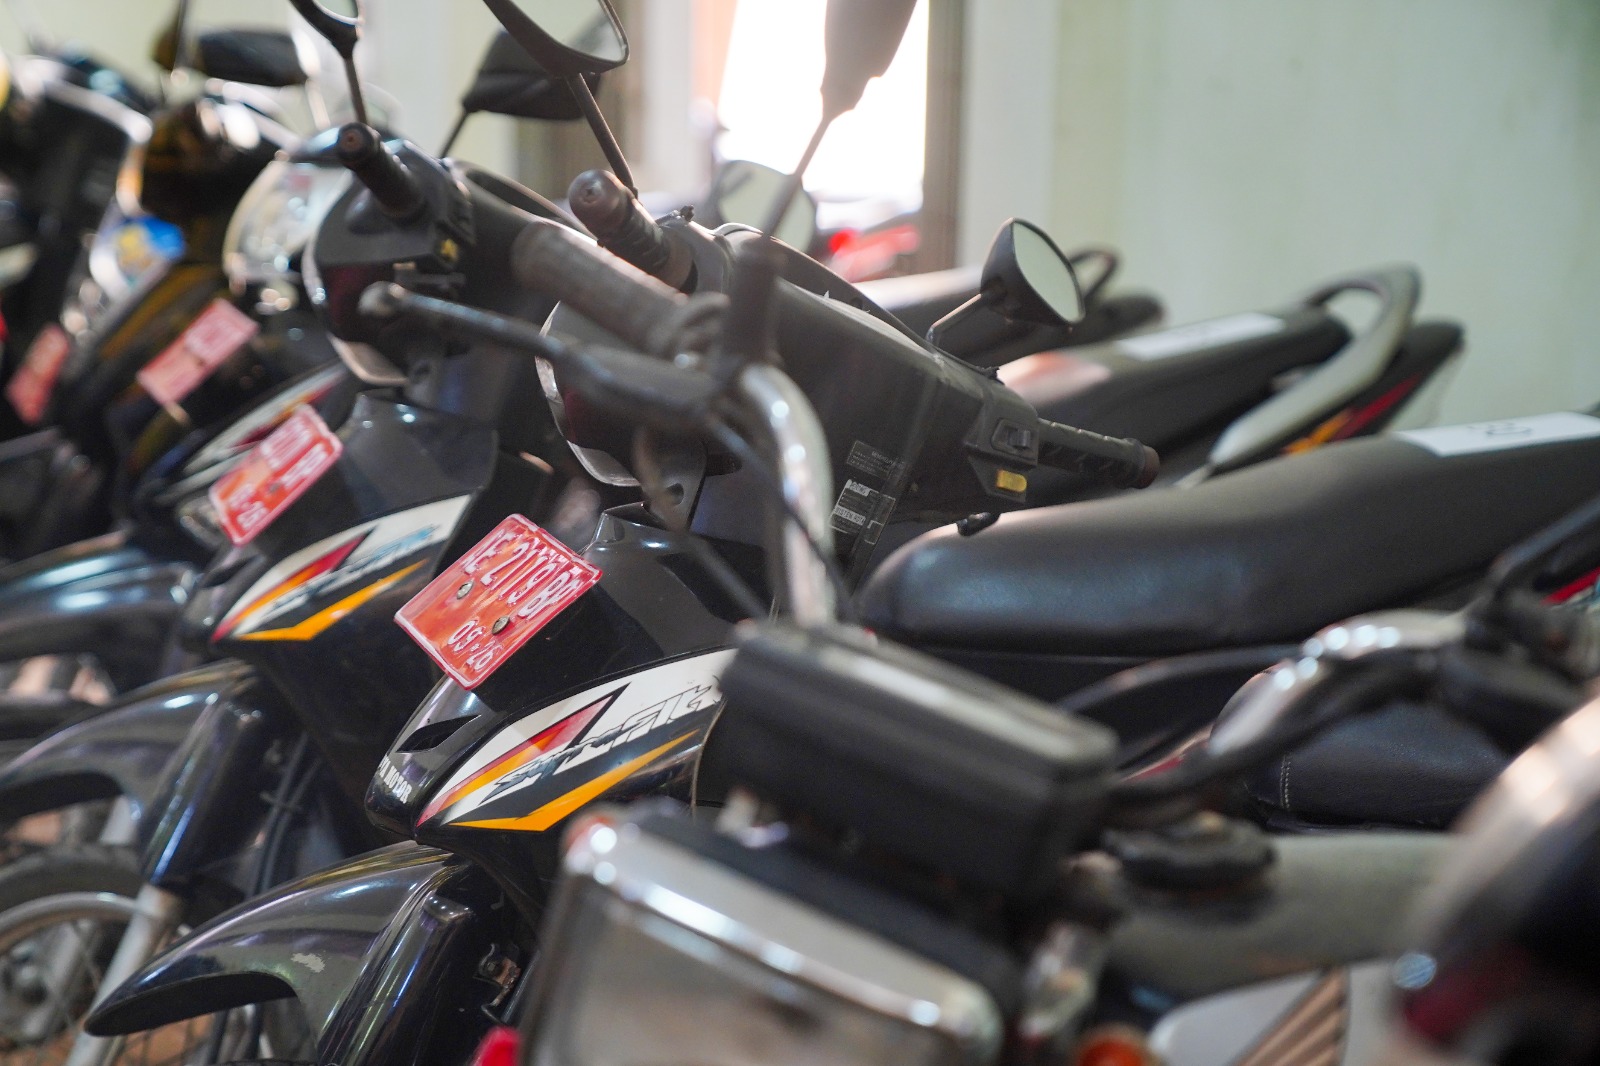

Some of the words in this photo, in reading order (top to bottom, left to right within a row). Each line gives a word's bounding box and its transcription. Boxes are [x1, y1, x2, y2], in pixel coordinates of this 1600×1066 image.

[480, 541, 558, 606] 2119
[517, 570, 582, 622] BP
[384, 765, 412, 804] MOTOR
